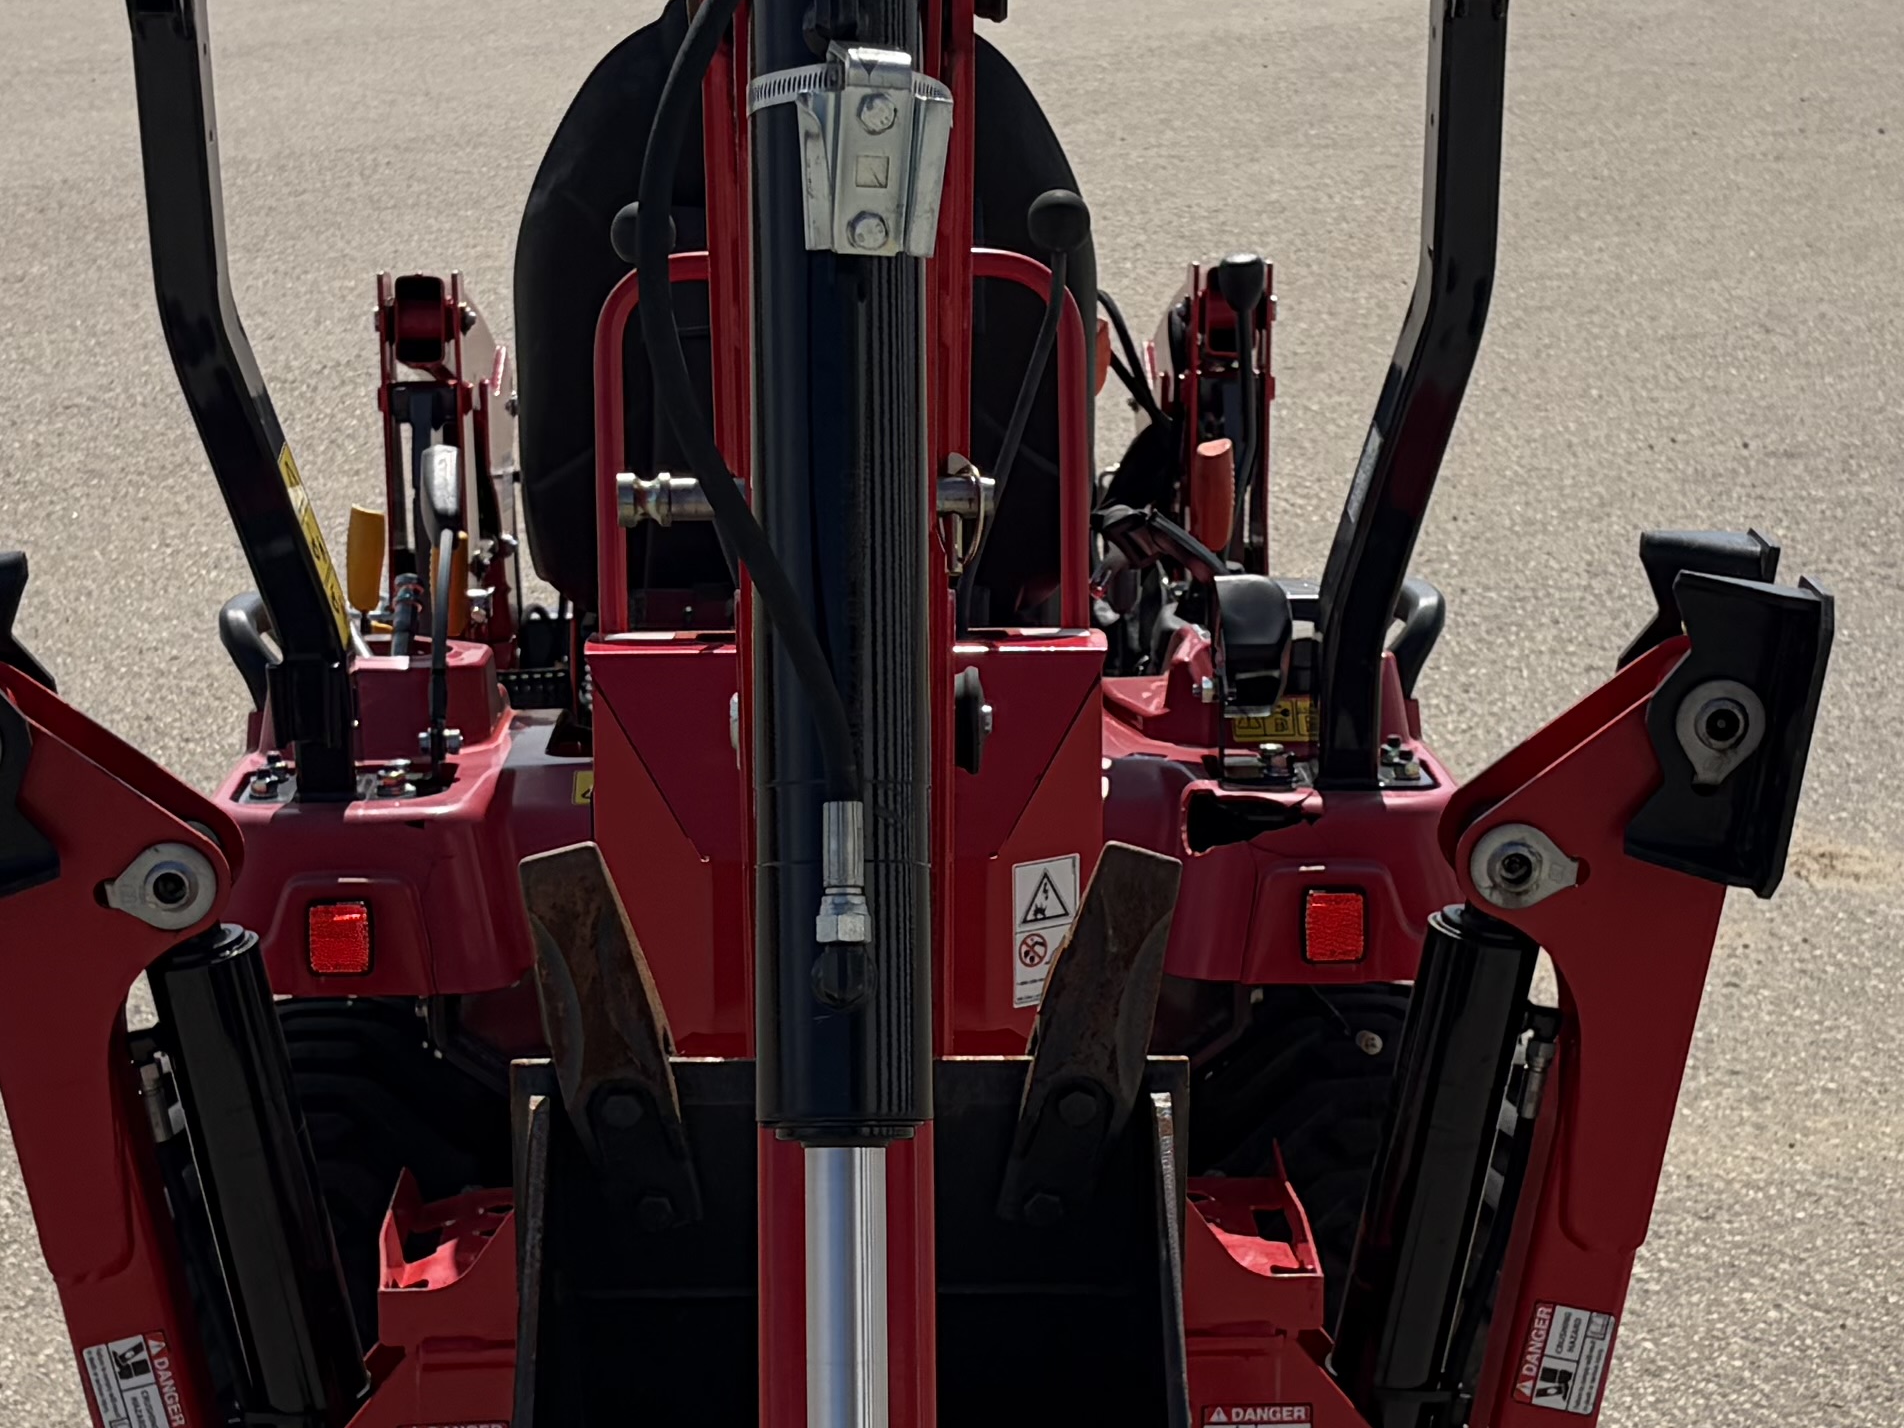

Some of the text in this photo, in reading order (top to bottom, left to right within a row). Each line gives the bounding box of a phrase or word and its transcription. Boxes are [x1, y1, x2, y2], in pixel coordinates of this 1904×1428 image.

[1522, 1307, 1553, 1376] DANGER
[1555, 1312, 1572, 1354] CRUSHING
[1567, 1317, 1582, 1352] HAZARD
[153, 1357, 186, 1427] DANGER
[1231, 1406, 1306, 1422] DANGER
